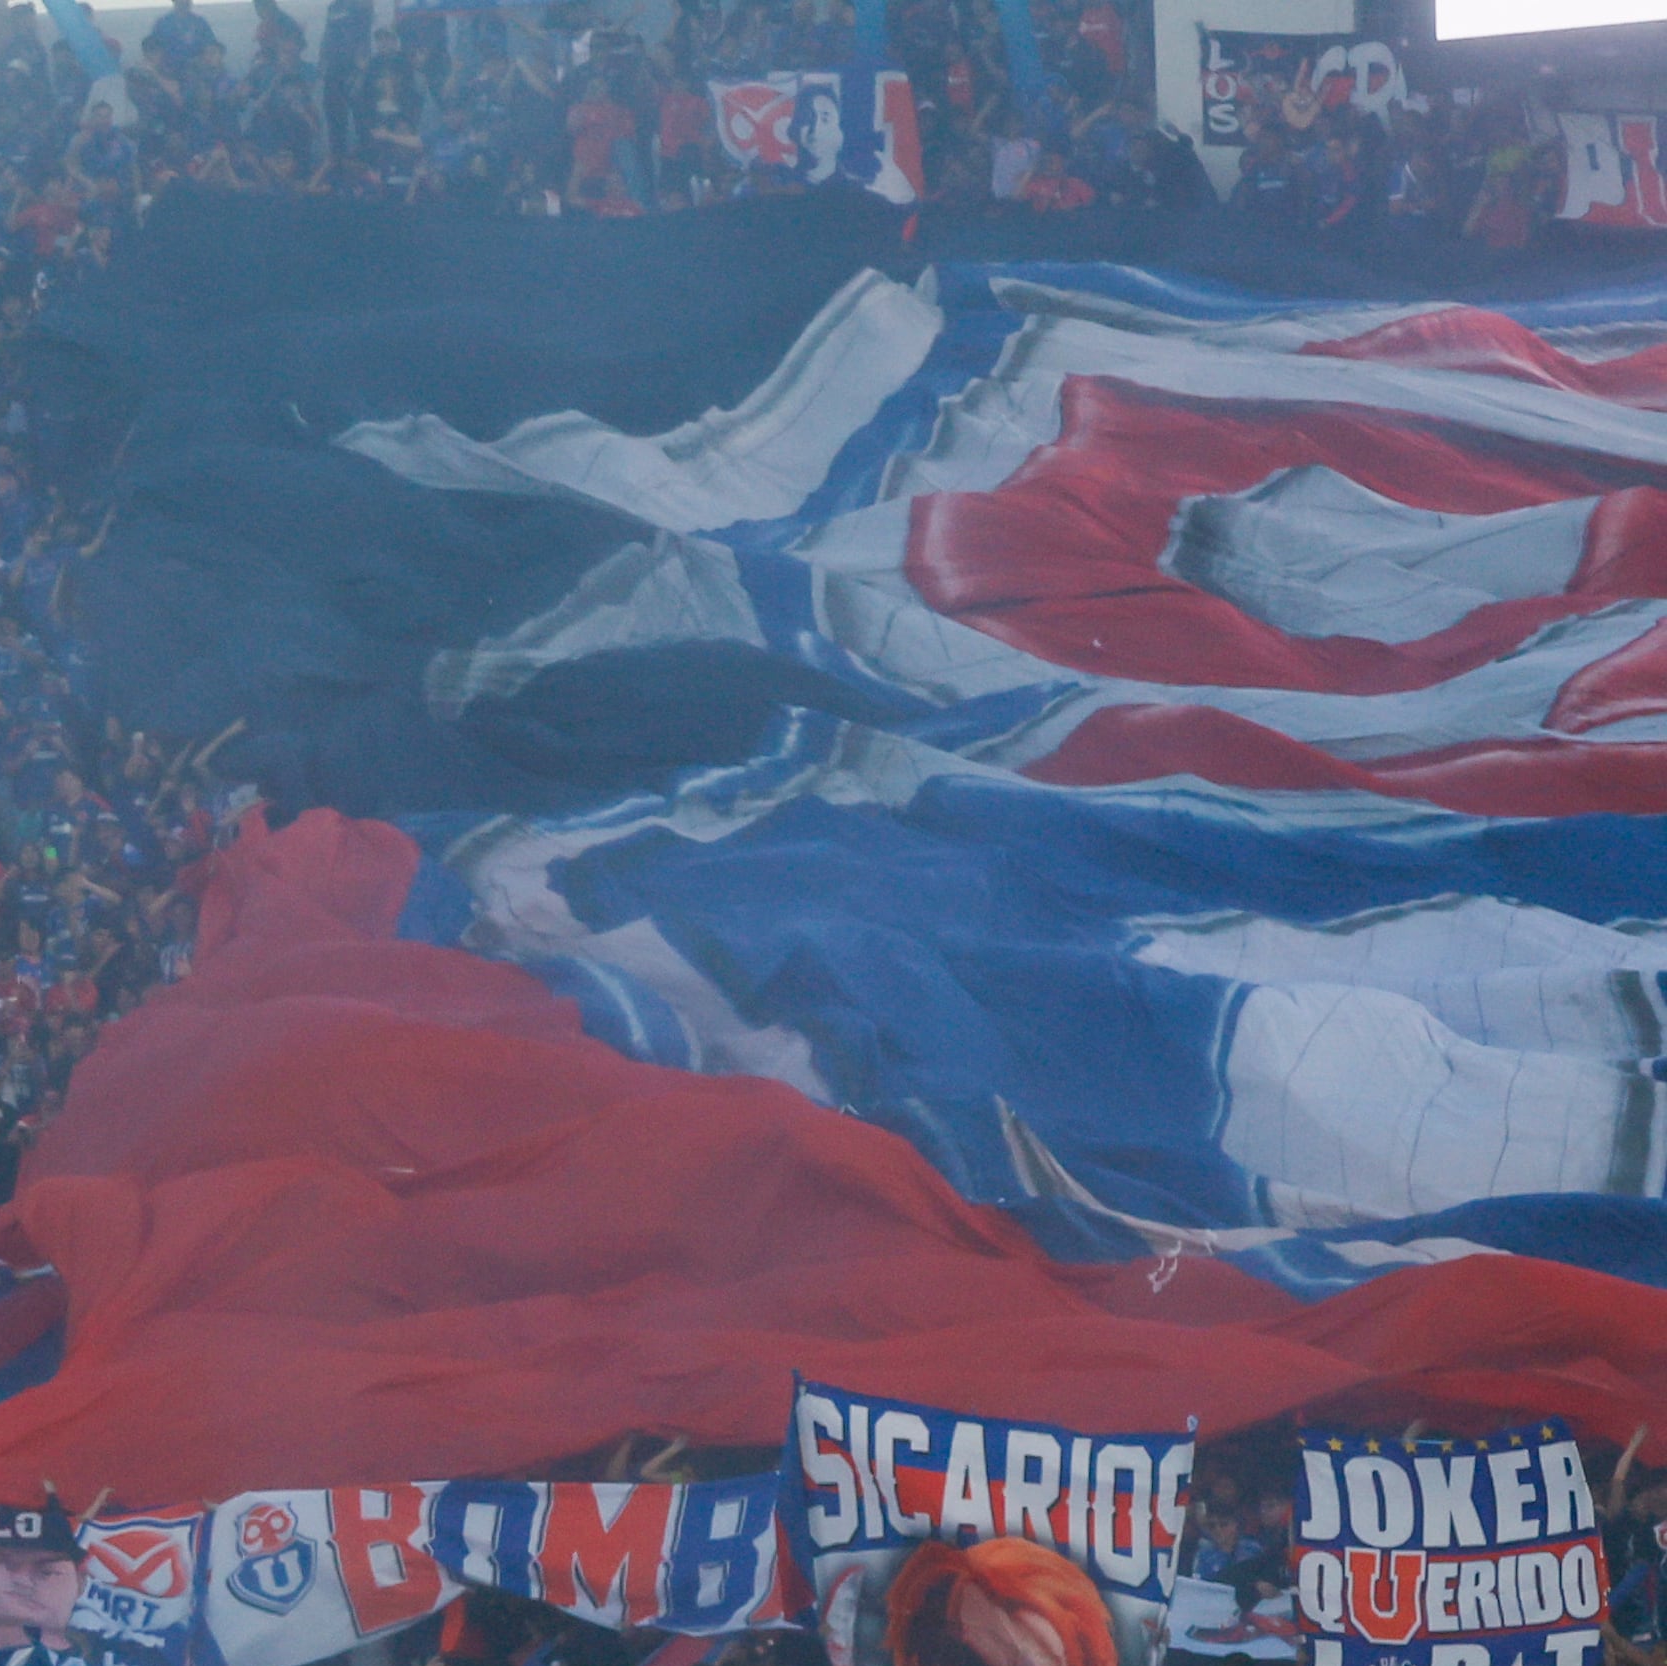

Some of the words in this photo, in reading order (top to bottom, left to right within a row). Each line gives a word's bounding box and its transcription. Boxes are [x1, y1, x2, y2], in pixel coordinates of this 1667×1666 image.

[795, 1392, 1193, 1600] SICARIOS
[1299, 1440, 1595, 1546] JOKER
[1297, 1543, 1599, 1646] QUERIDO
